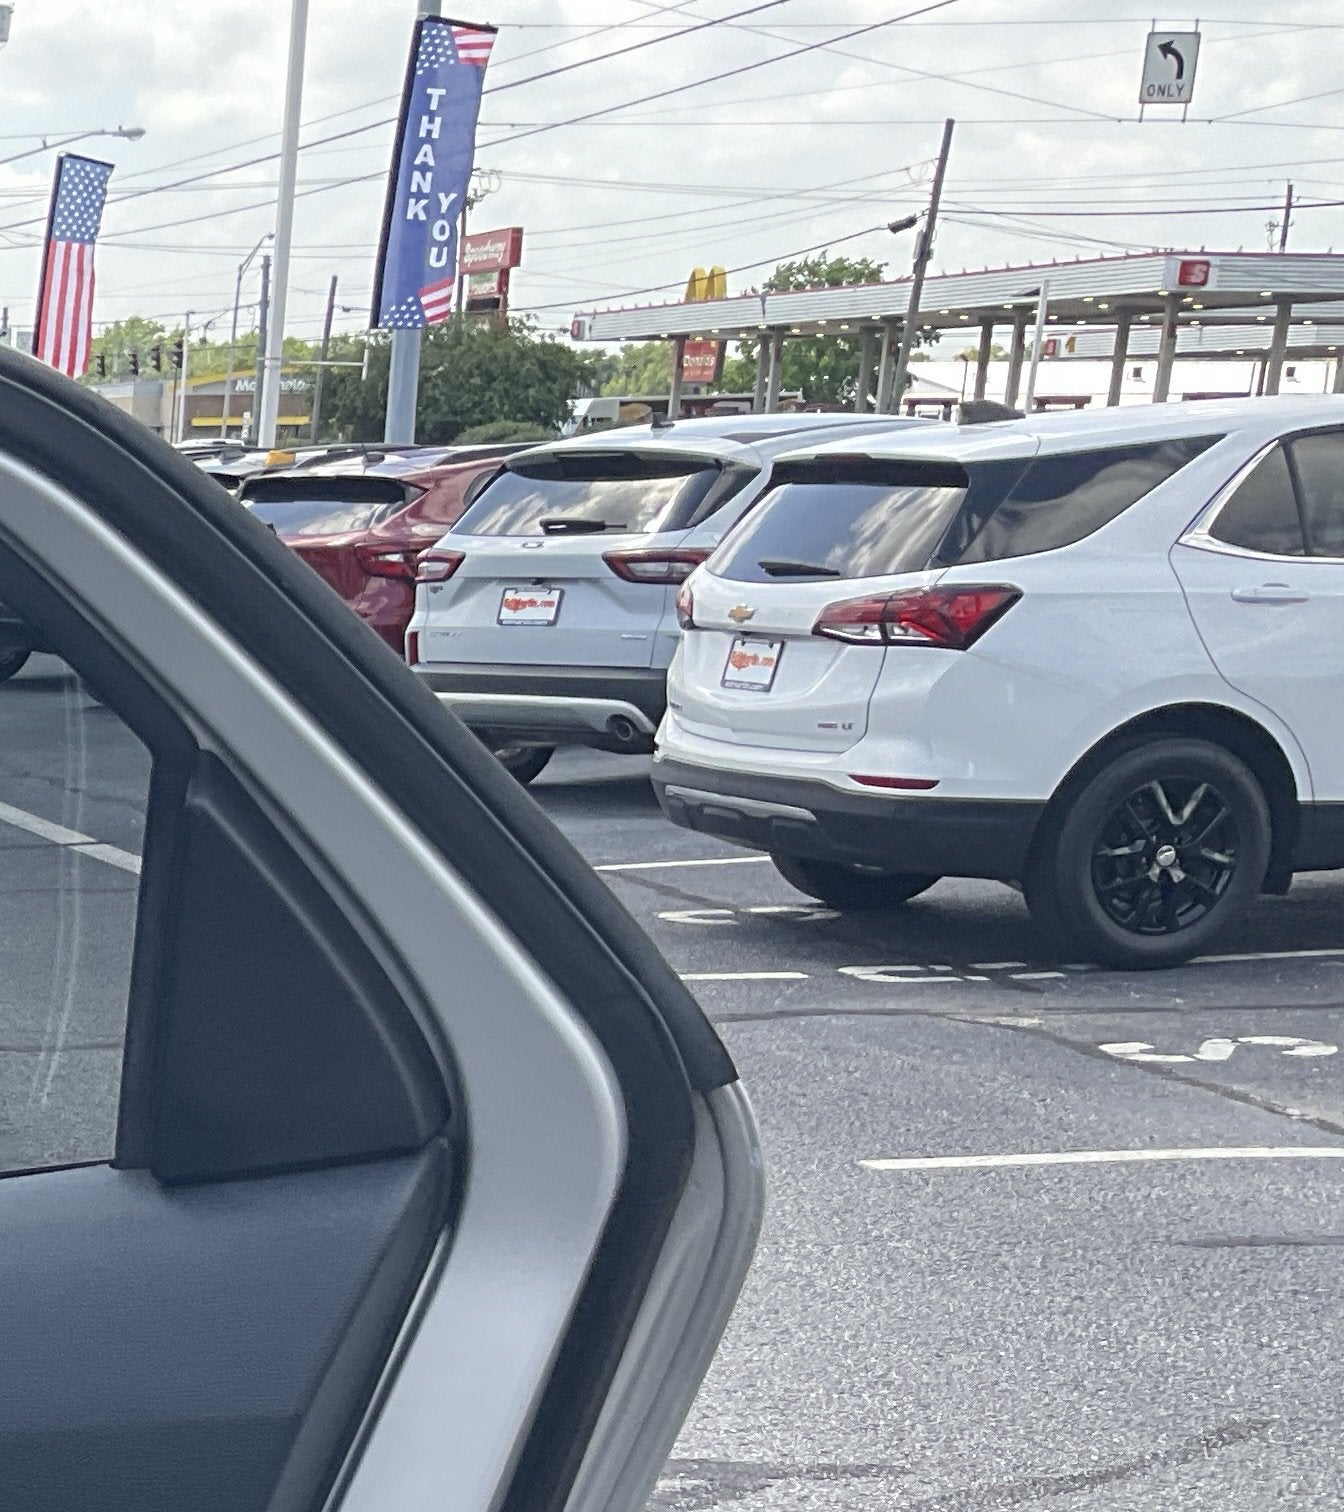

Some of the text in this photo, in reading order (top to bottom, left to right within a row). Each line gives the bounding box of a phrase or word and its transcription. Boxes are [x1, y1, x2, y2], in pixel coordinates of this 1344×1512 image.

[1146, 83, 1186, 98] ONLY
[406, 87, 447, 221] THANK
[429, 192, 458, 268] YOU
